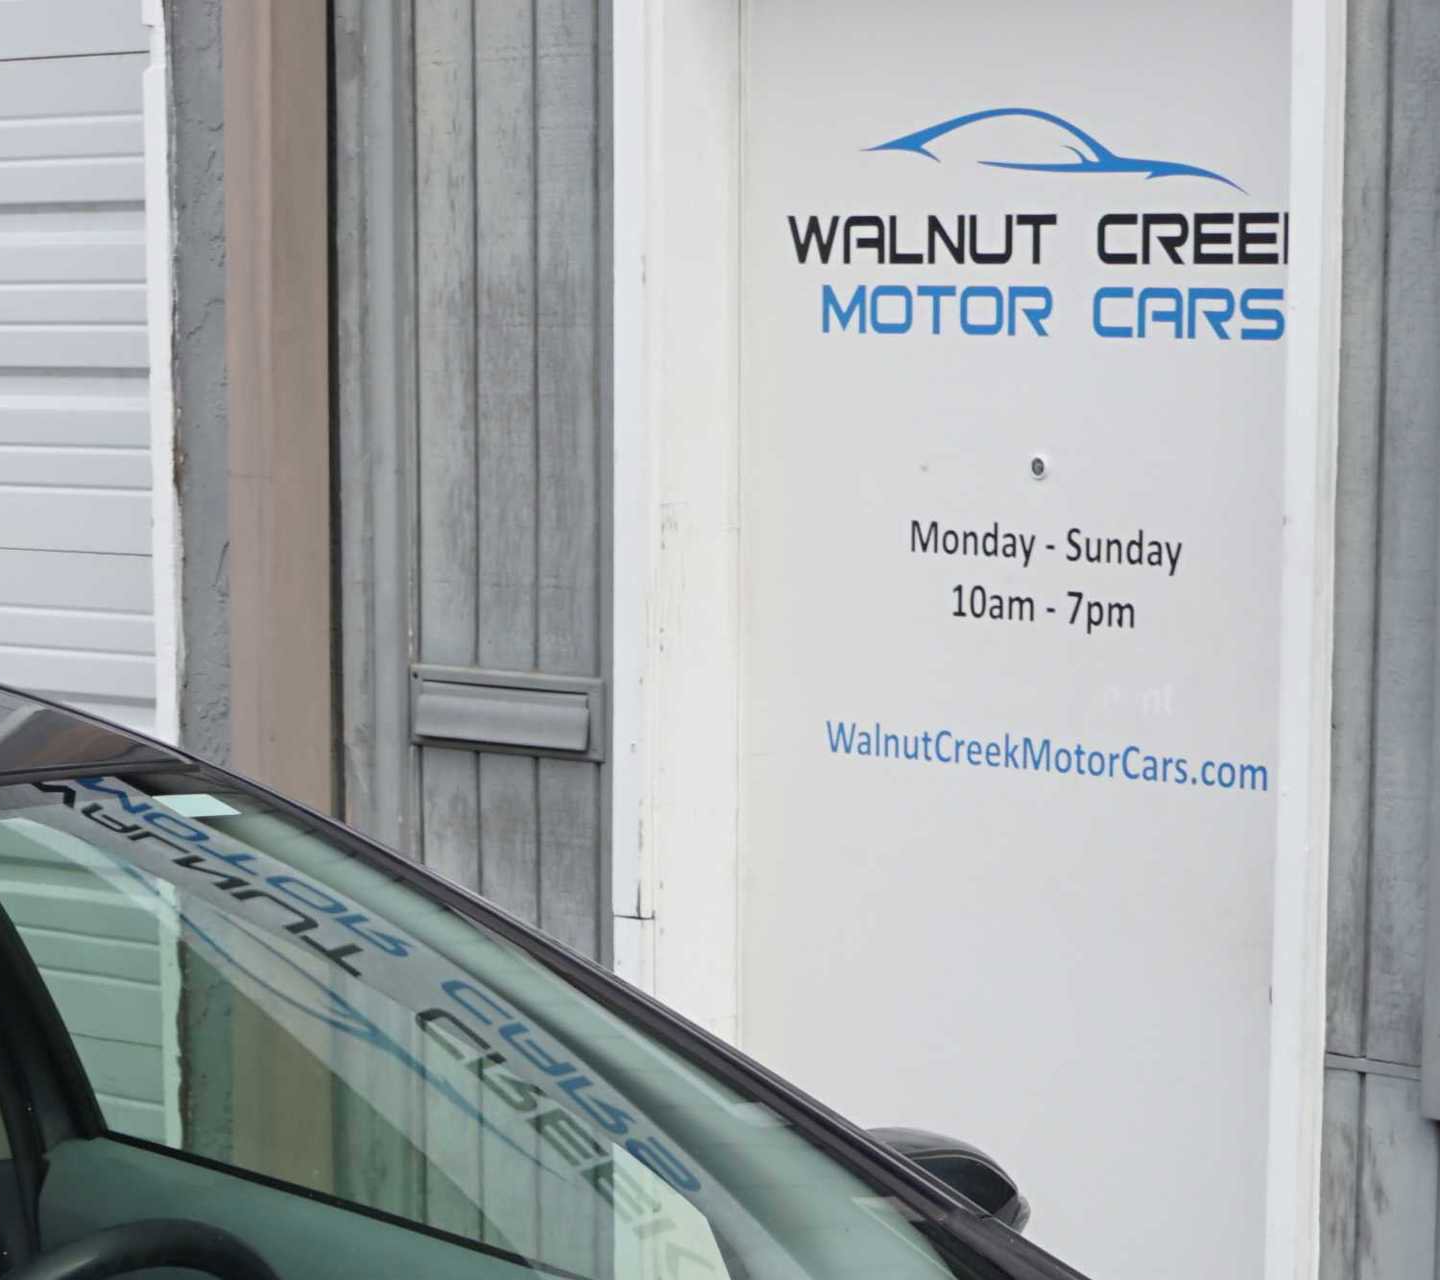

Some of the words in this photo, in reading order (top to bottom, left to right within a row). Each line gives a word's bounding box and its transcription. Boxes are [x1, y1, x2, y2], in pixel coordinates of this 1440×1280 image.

[787, 213, 1057, 265] WALNUT
[1096, 211, 1289, 265] CREE
[822, 284, 1053, 337] MOTOR
[1092, 286, 1286, 341] CARS
[910, 519, 1036, 568] Monday
[1065, 527, 1183, 576] Sunday
[951, 583, 1035, 622] 10am
[1066, 590, 1135, 635] 7pm
[826, 721, 1269, 792] WalnutCreekMotorCars.com
